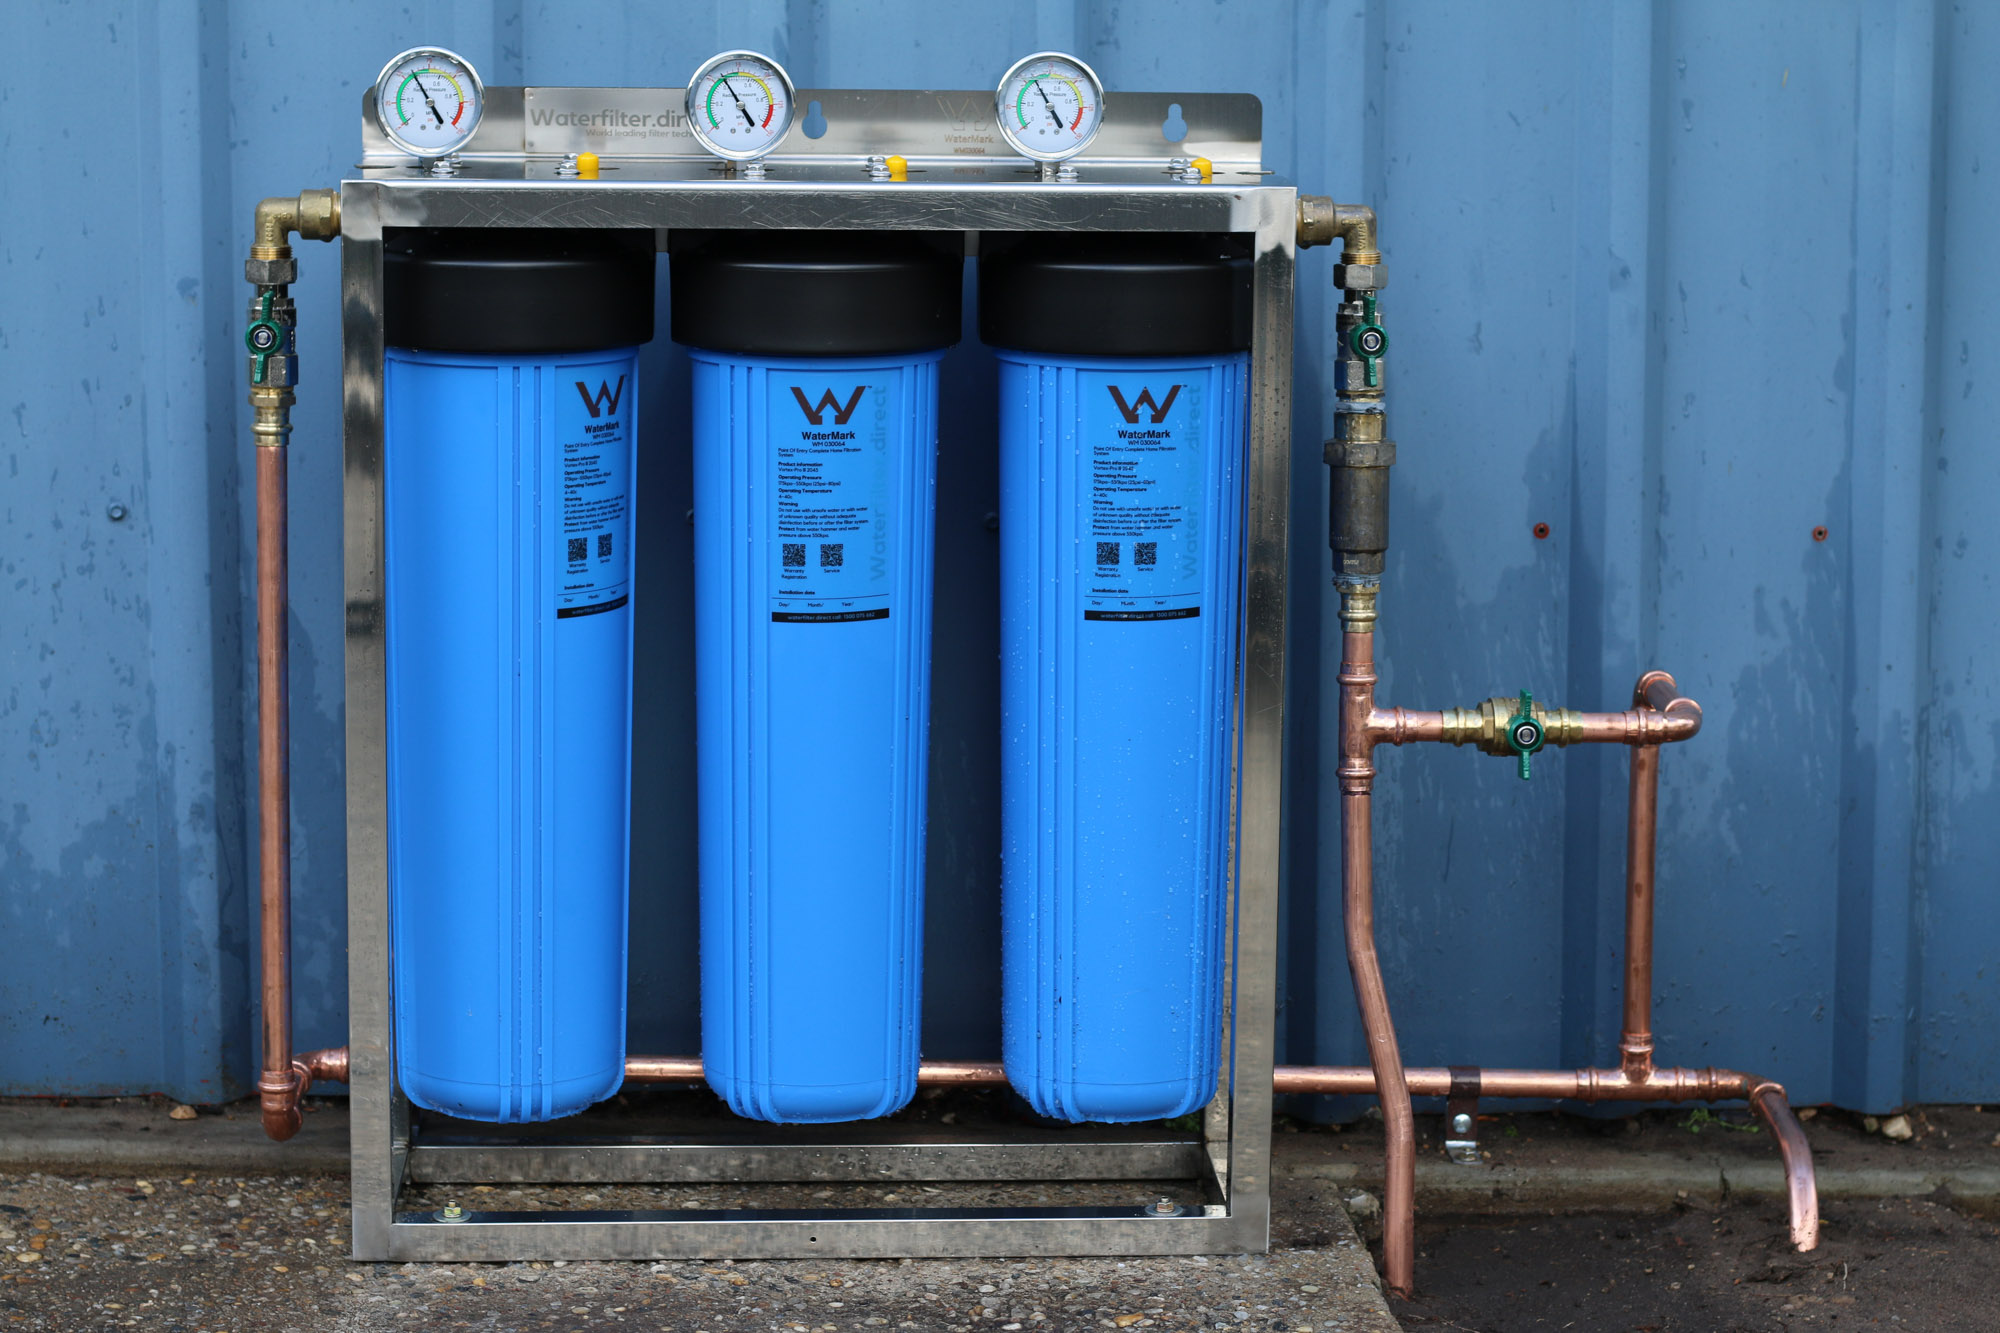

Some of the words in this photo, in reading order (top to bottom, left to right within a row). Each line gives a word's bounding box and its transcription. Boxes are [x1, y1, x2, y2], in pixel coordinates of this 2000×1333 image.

[615, 130, 646, 139] leading
[944, 134, 994, 143] WaterMark
[585, 421, 619, 434] WaterMark
[802, 432, 855, 440] WaterMark
[1118, 431, 1170, 439] WaterMark
